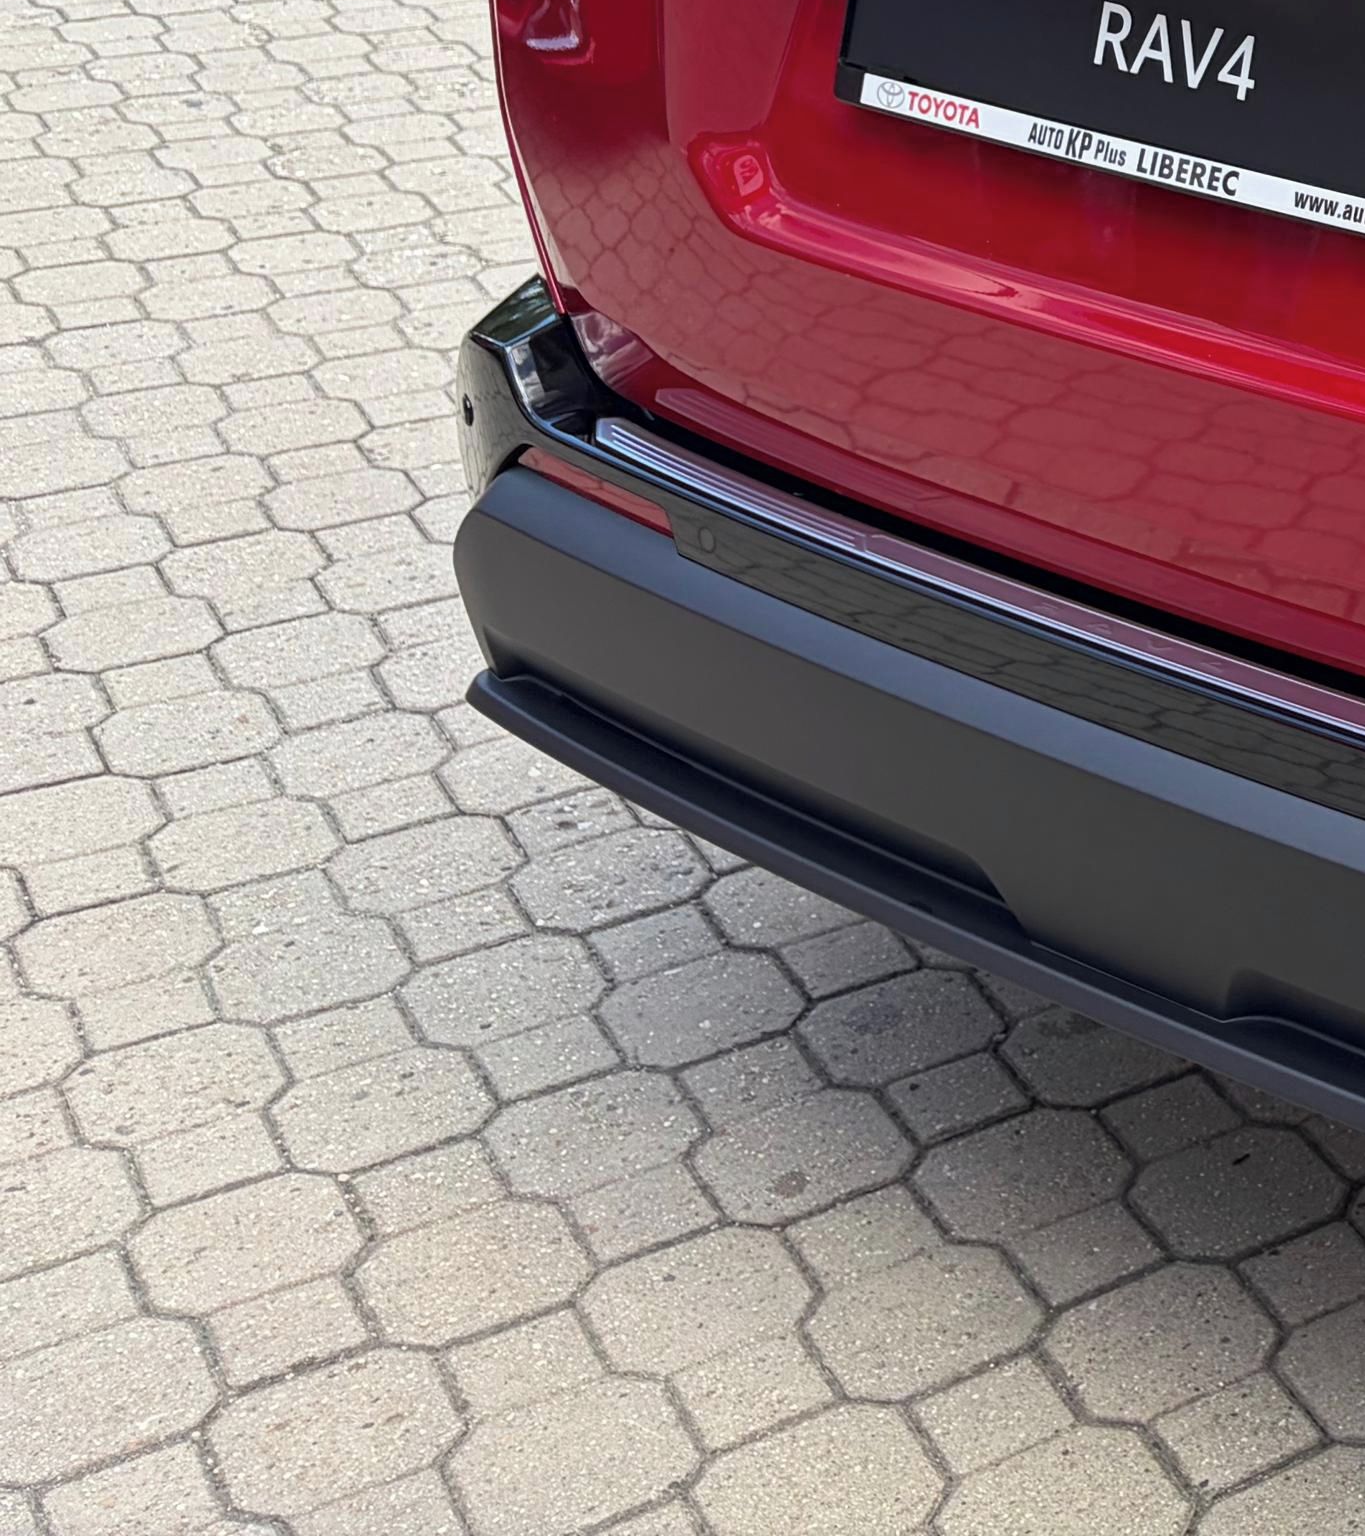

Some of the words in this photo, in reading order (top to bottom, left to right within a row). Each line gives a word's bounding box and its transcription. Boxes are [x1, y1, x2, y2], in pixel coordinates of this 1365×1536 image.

[1093, 1, 1256, 101] RAV4
[908, 90, 980, 129] TOYOTA
[1028, 122, 1064, 151] AUTO
[1065, 127, 1093, 160] KP
[1094, 139, 1127, 167] Plus
[1136, 148, 1240, 197] LIBEREC
